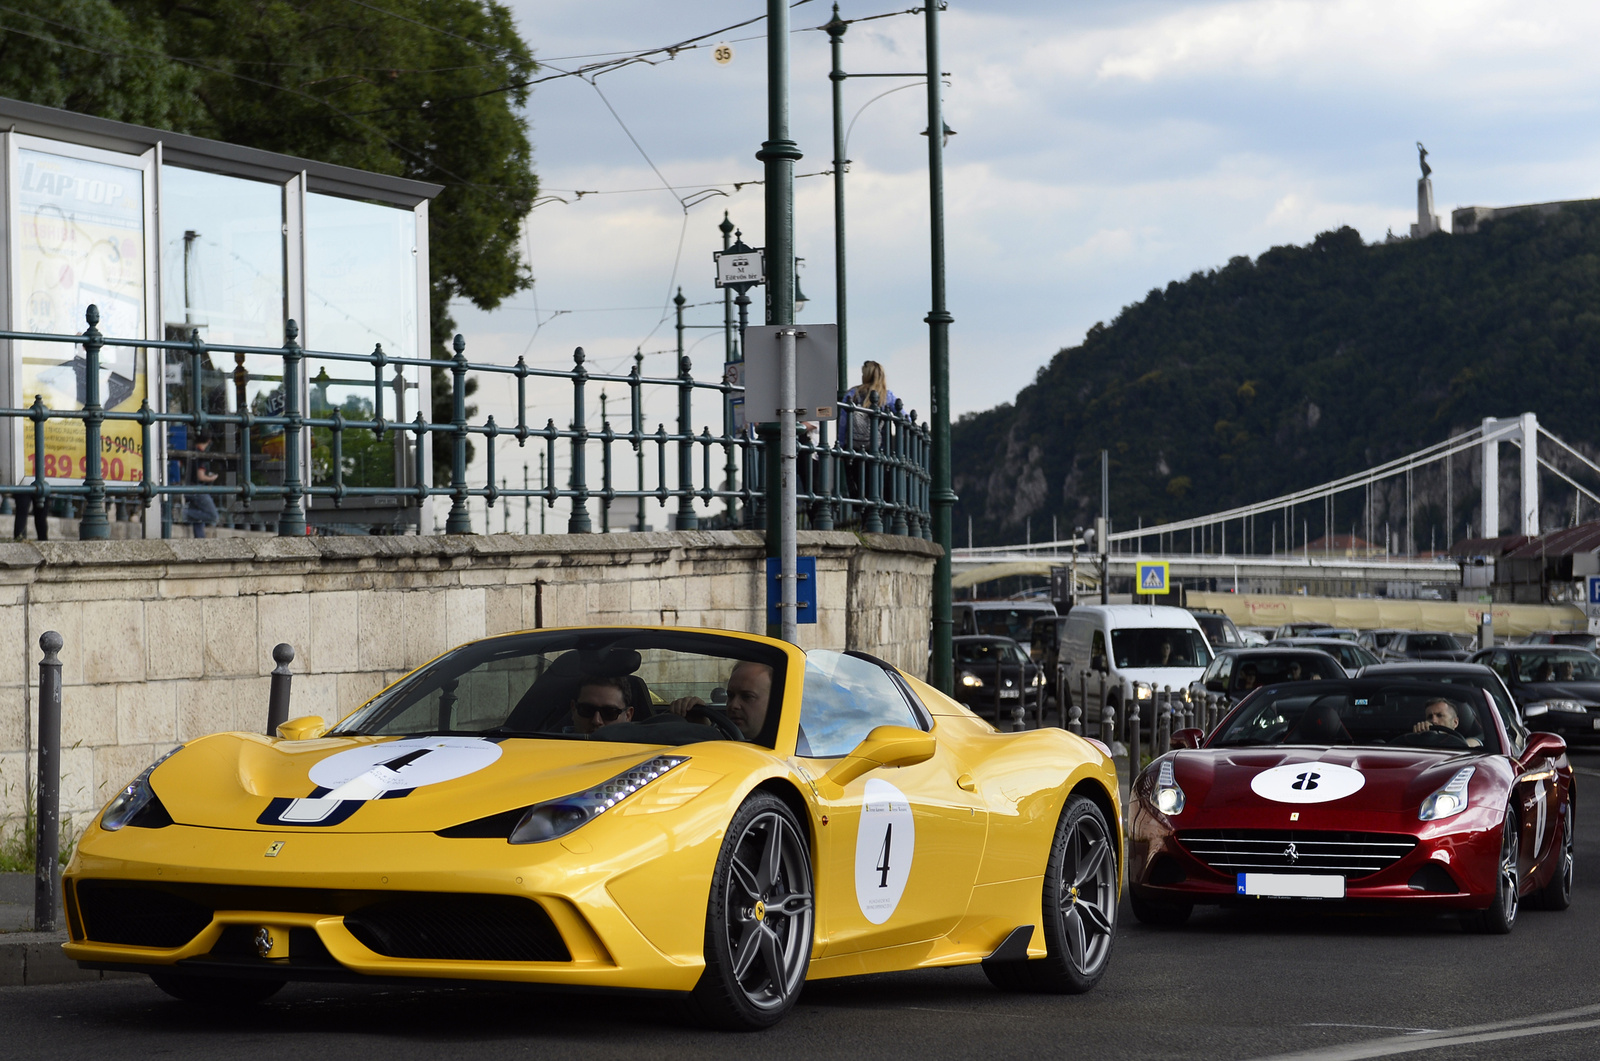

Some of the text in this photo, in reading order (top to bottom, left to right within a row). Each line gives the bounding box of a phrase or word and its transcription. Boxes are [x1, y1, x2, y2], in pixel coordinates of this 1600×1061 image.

[715, 48, 731, 61] 35
[21, 162, 122, 205] LAPTOP
[115, 436, 135, 453] 990
[1291, 772, 1321, 791] 8
[876, 823, 892, 888] 4
